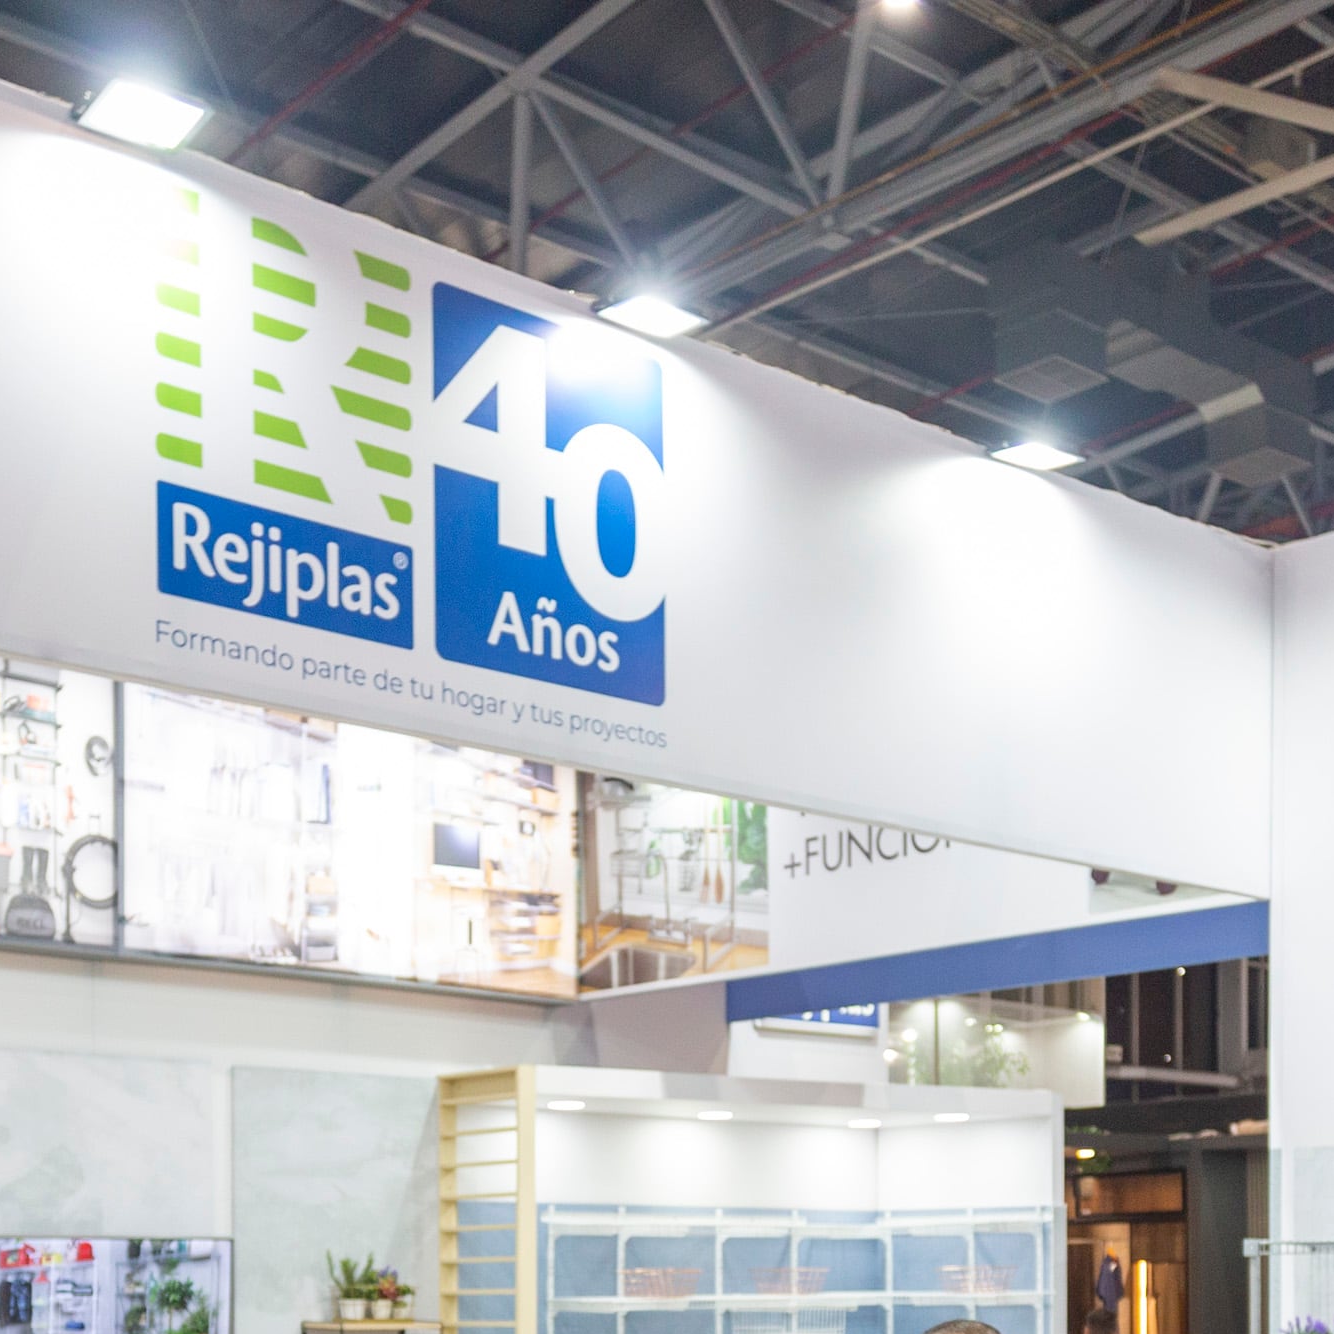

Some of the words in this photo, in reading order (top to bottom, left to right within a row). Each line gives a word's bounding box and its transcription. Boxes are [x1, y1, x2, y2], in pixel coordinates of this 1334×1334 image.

[432, 323, 667, 623] 40
[155, 619, 294, 672] Formando
[302, 652, 368, 688] parte
[373, 667, 404, 694] de
[410, 675, 434, 702] tu
[441, 682, 507, 717] hogar
[512, 699, 526, 724] y
[529, 701, 565, 728] tus
[569, 712, 668, 749] proyectos
[486, 590, 621, 673] Años
